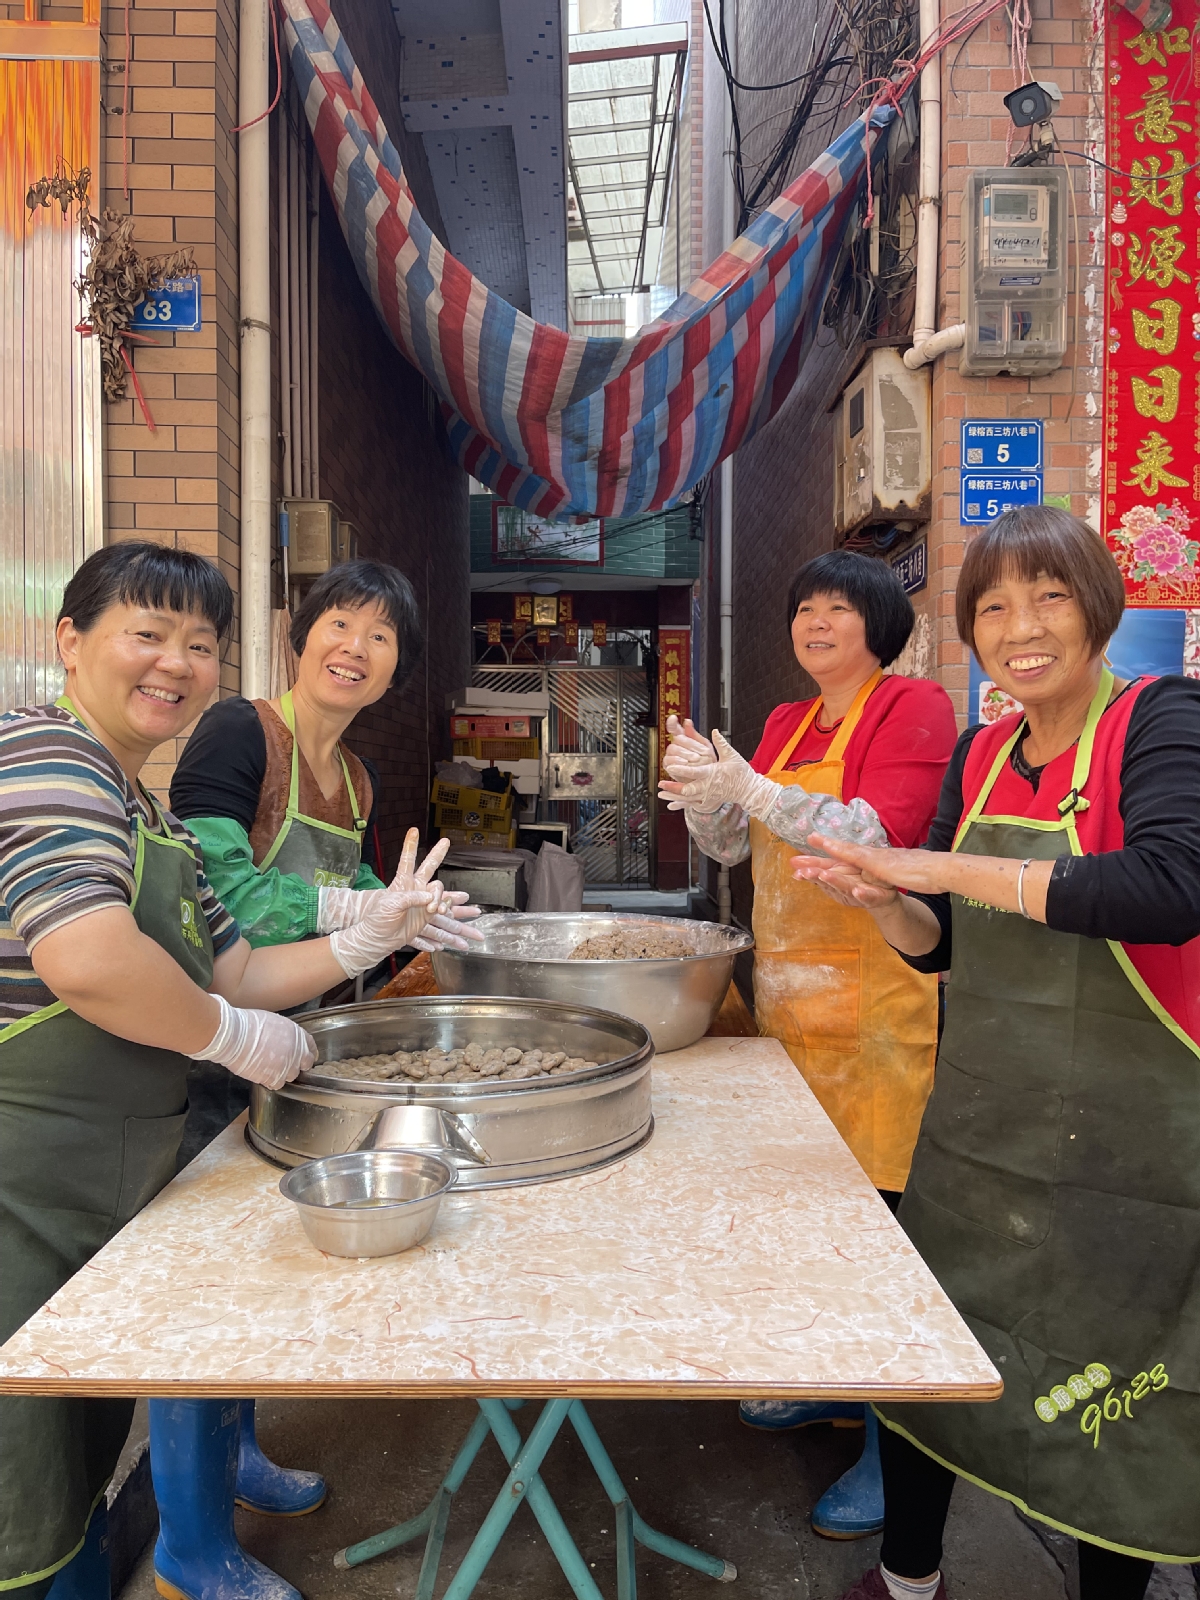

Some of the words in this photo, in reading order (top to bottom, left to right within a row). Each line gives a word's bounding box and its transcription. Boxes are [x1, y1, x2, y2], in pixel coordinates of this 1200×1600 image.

[143, 301, 172, 321] 63
[968, 426, 1028, 437] 绿榕西三坊八巷
[996, 443, 1010, 463] 5
[967, 480, 1028, 490] 绿榕西三坊八巷
[1080, 1363, 1169, 1449] 96123
